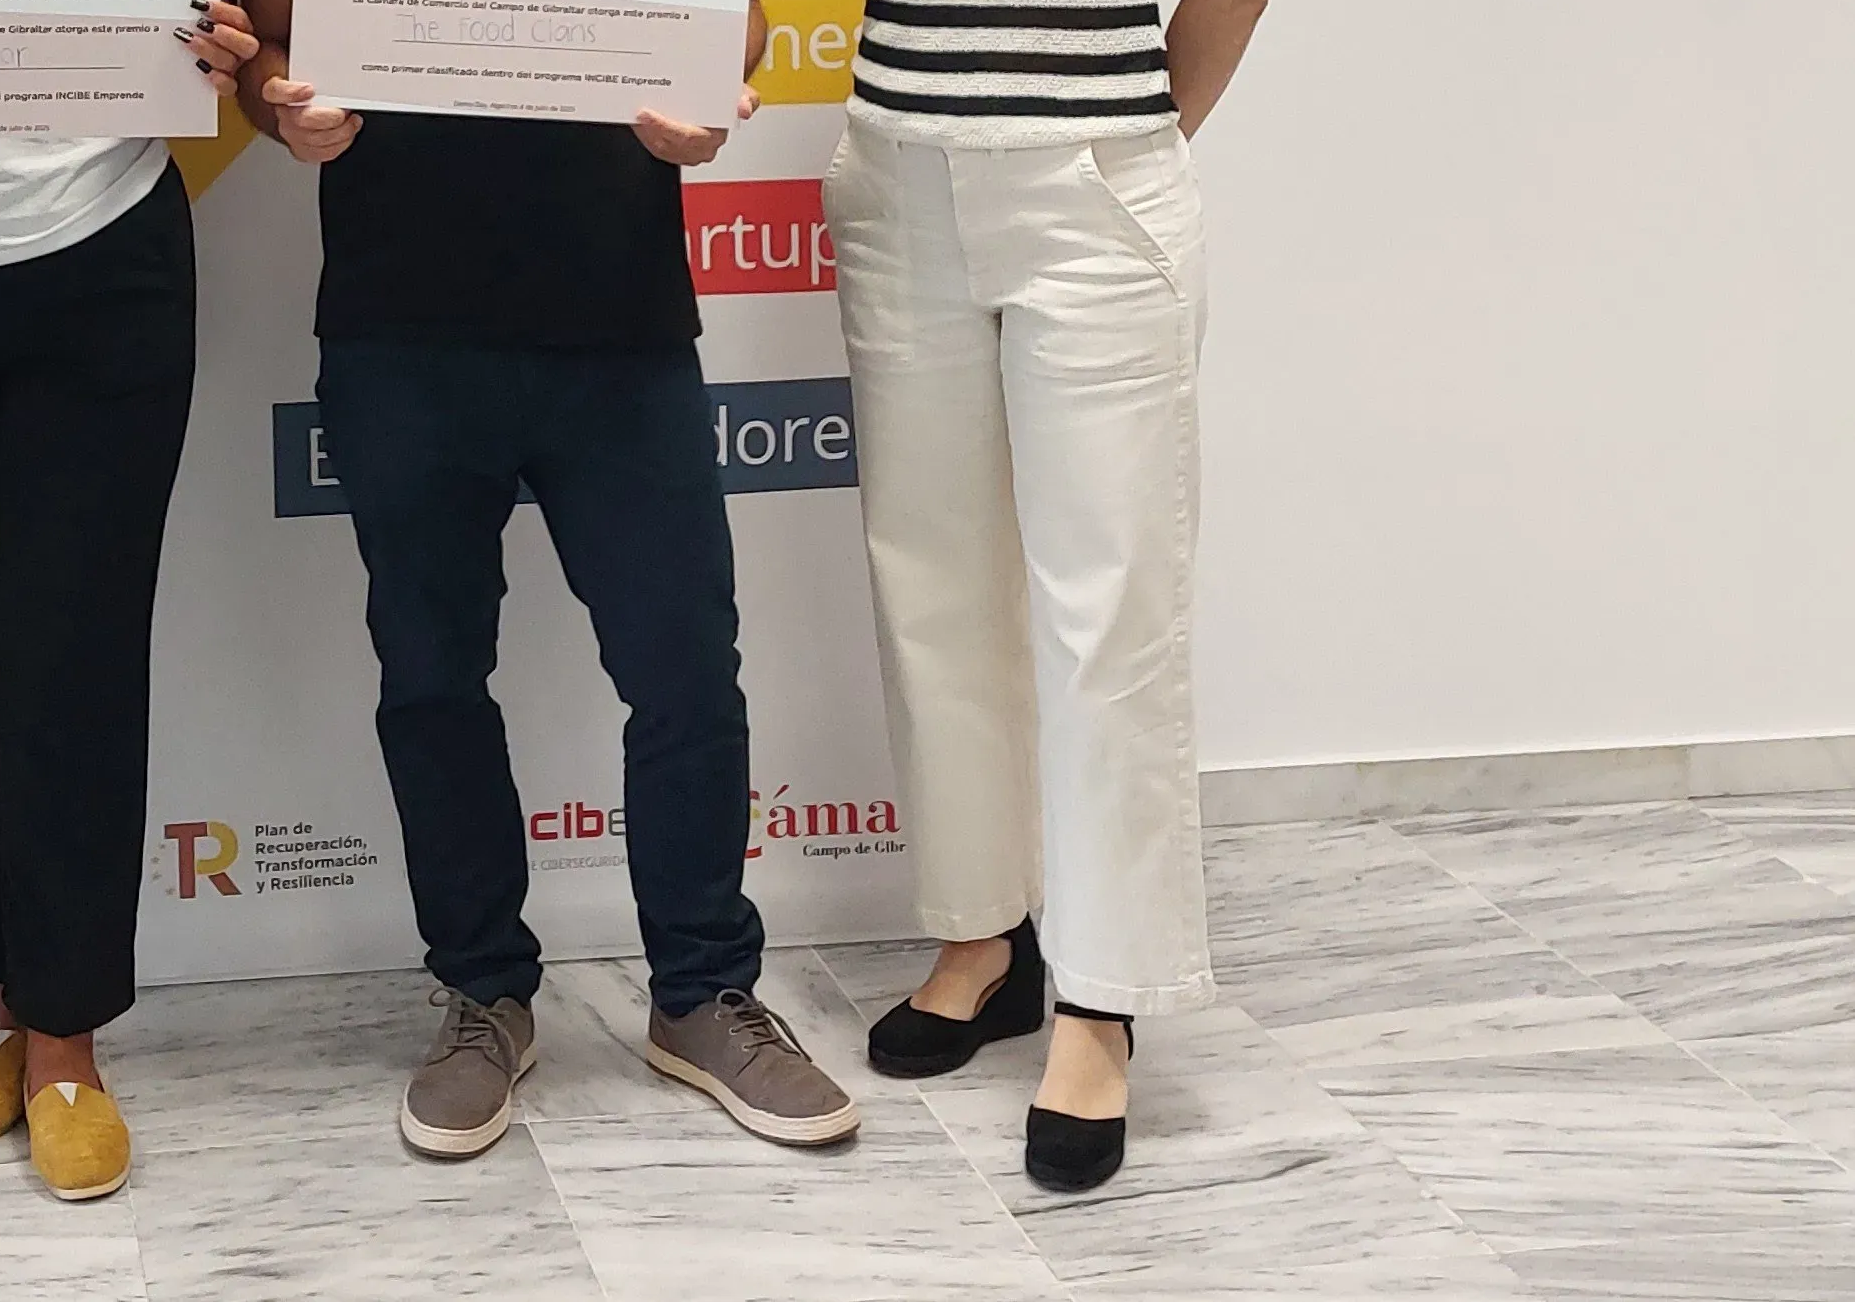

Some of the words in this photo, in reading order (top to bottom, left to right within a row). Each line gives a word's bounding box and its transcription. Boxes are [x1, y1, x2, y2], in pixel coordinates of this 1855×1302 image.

[527, 4, 539, 12] de
[93, 91, 145, 101] Emprende
[255, 824, 288, 837] Plan
[293, 822, 313, 835] de
[255, 835, 368, 855] Recuperación,
[802, 843, 851, 860] Campo
[854, 841, 872, 856] de
[254, 853, 378, 873] Transformación
[256, 880, 265, 894] y
[270, 872, 354, 891] Resiliencia
